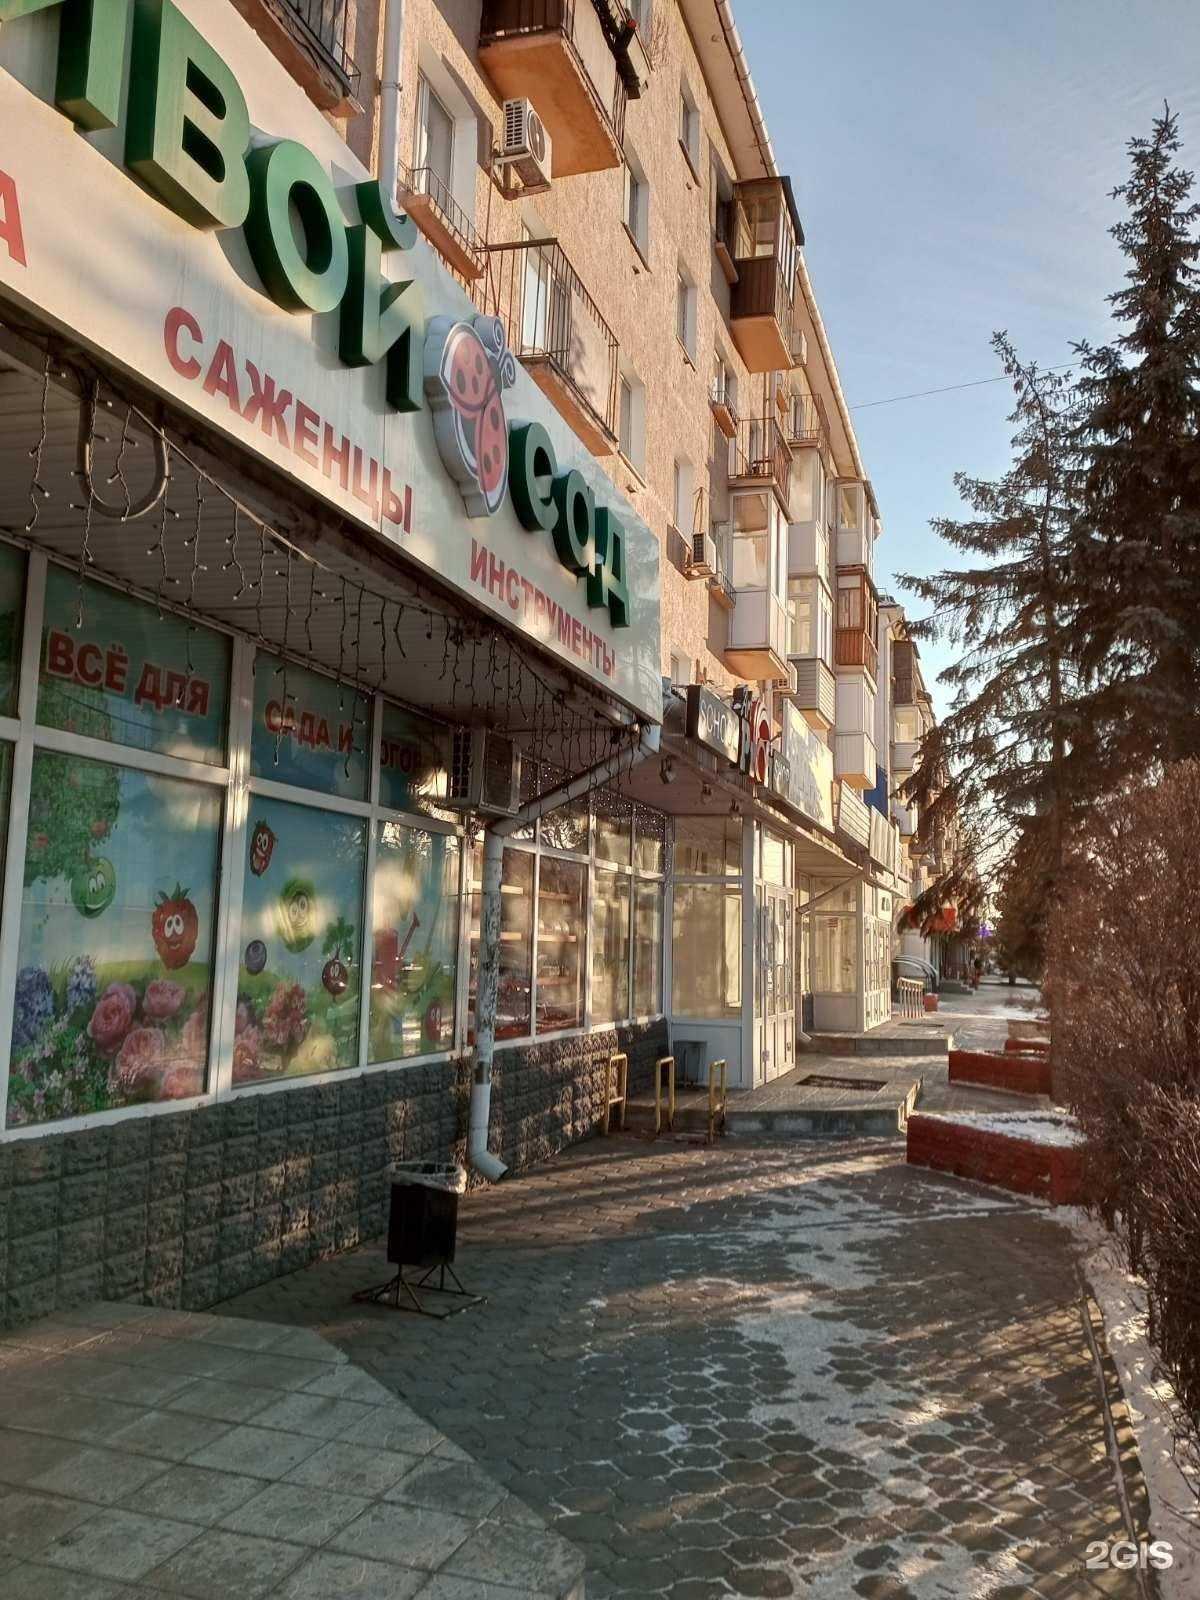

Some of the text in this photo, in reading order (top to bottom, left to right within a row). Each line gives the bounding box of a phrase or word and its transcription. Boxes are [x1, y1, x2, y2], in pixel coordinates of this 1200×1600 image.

[163, 306, 413, 534] САЖЕНЦЫ
[469, 537, 616, 678] ИНСТРУМЕНТЫ
[47, 630, 129, 693] ВСЁ
[134, 662, 210, 717] ДЛЯ
[264, 699, 331, 751] САДА
[338, 721, 353, 753] И
